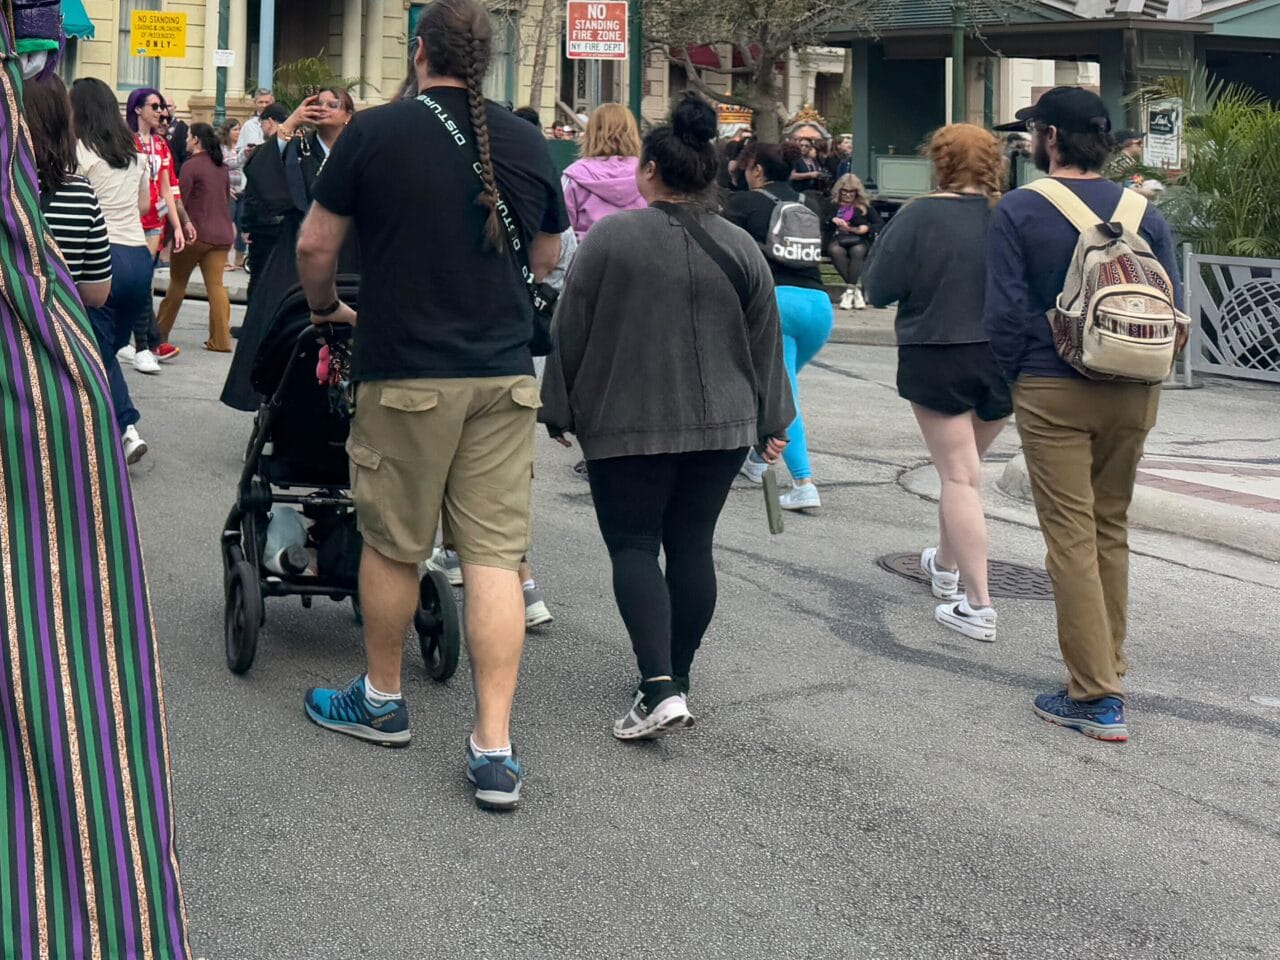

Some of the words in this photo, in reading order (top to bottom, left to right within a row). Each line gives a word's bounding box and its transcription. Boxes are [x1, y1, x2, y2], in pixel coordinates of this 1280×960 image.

[588, 4, 607, 19] NO
[137, 15, 147, 23] NO
[150, 15, 180, 24] STANDING
[574, 20, 620, 30] STANDING
[572, 30, 593, 40] FIRE
[597, 30, 622, 41] ZONE
[584, 43, 601, 51] FIRE
